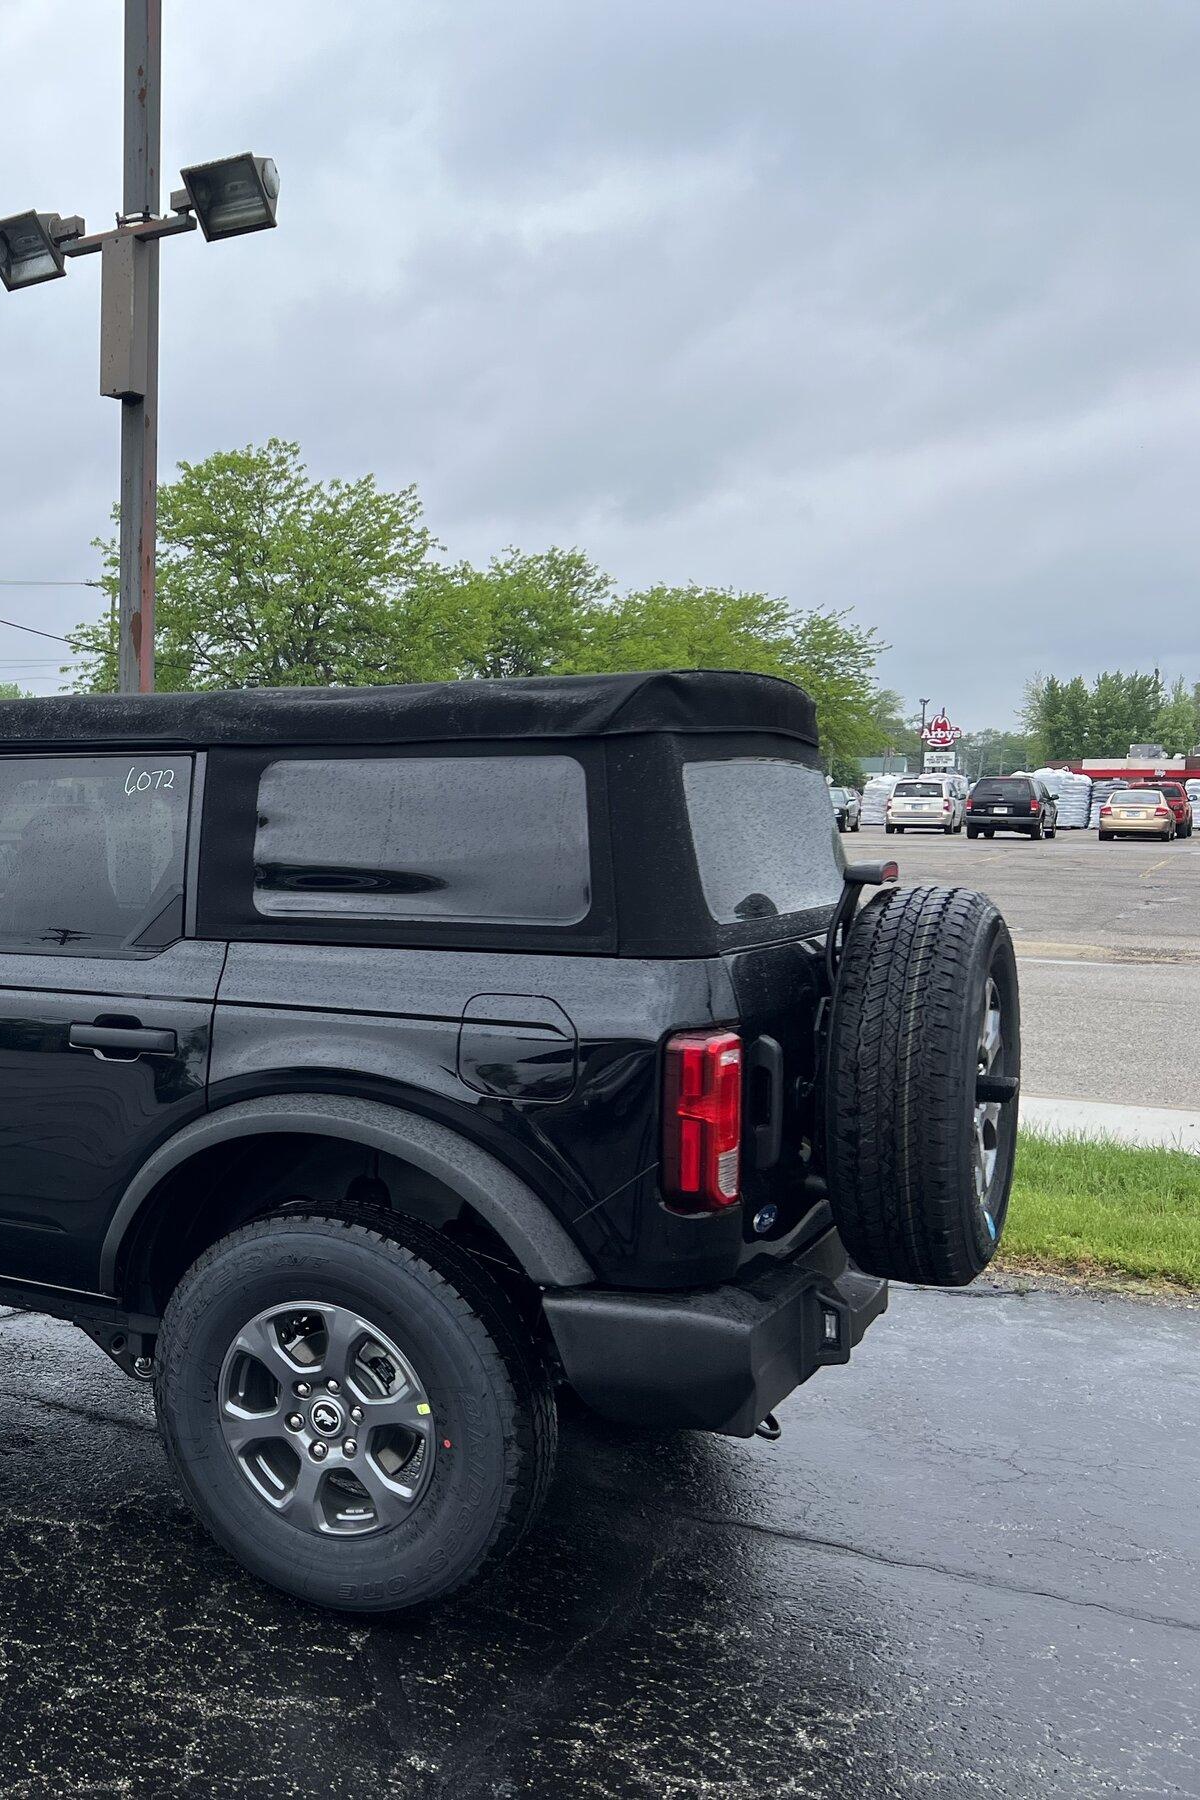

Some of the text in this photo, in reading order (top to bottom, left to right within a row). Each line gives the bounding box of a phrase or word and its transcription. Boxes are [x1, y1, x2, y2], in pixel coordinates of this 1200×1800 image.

[921, 727, 961, 740] Arby's
[125, 767, 175, 796] 6072
[337, 1391, 490, 1601] BRIDGESTONE
